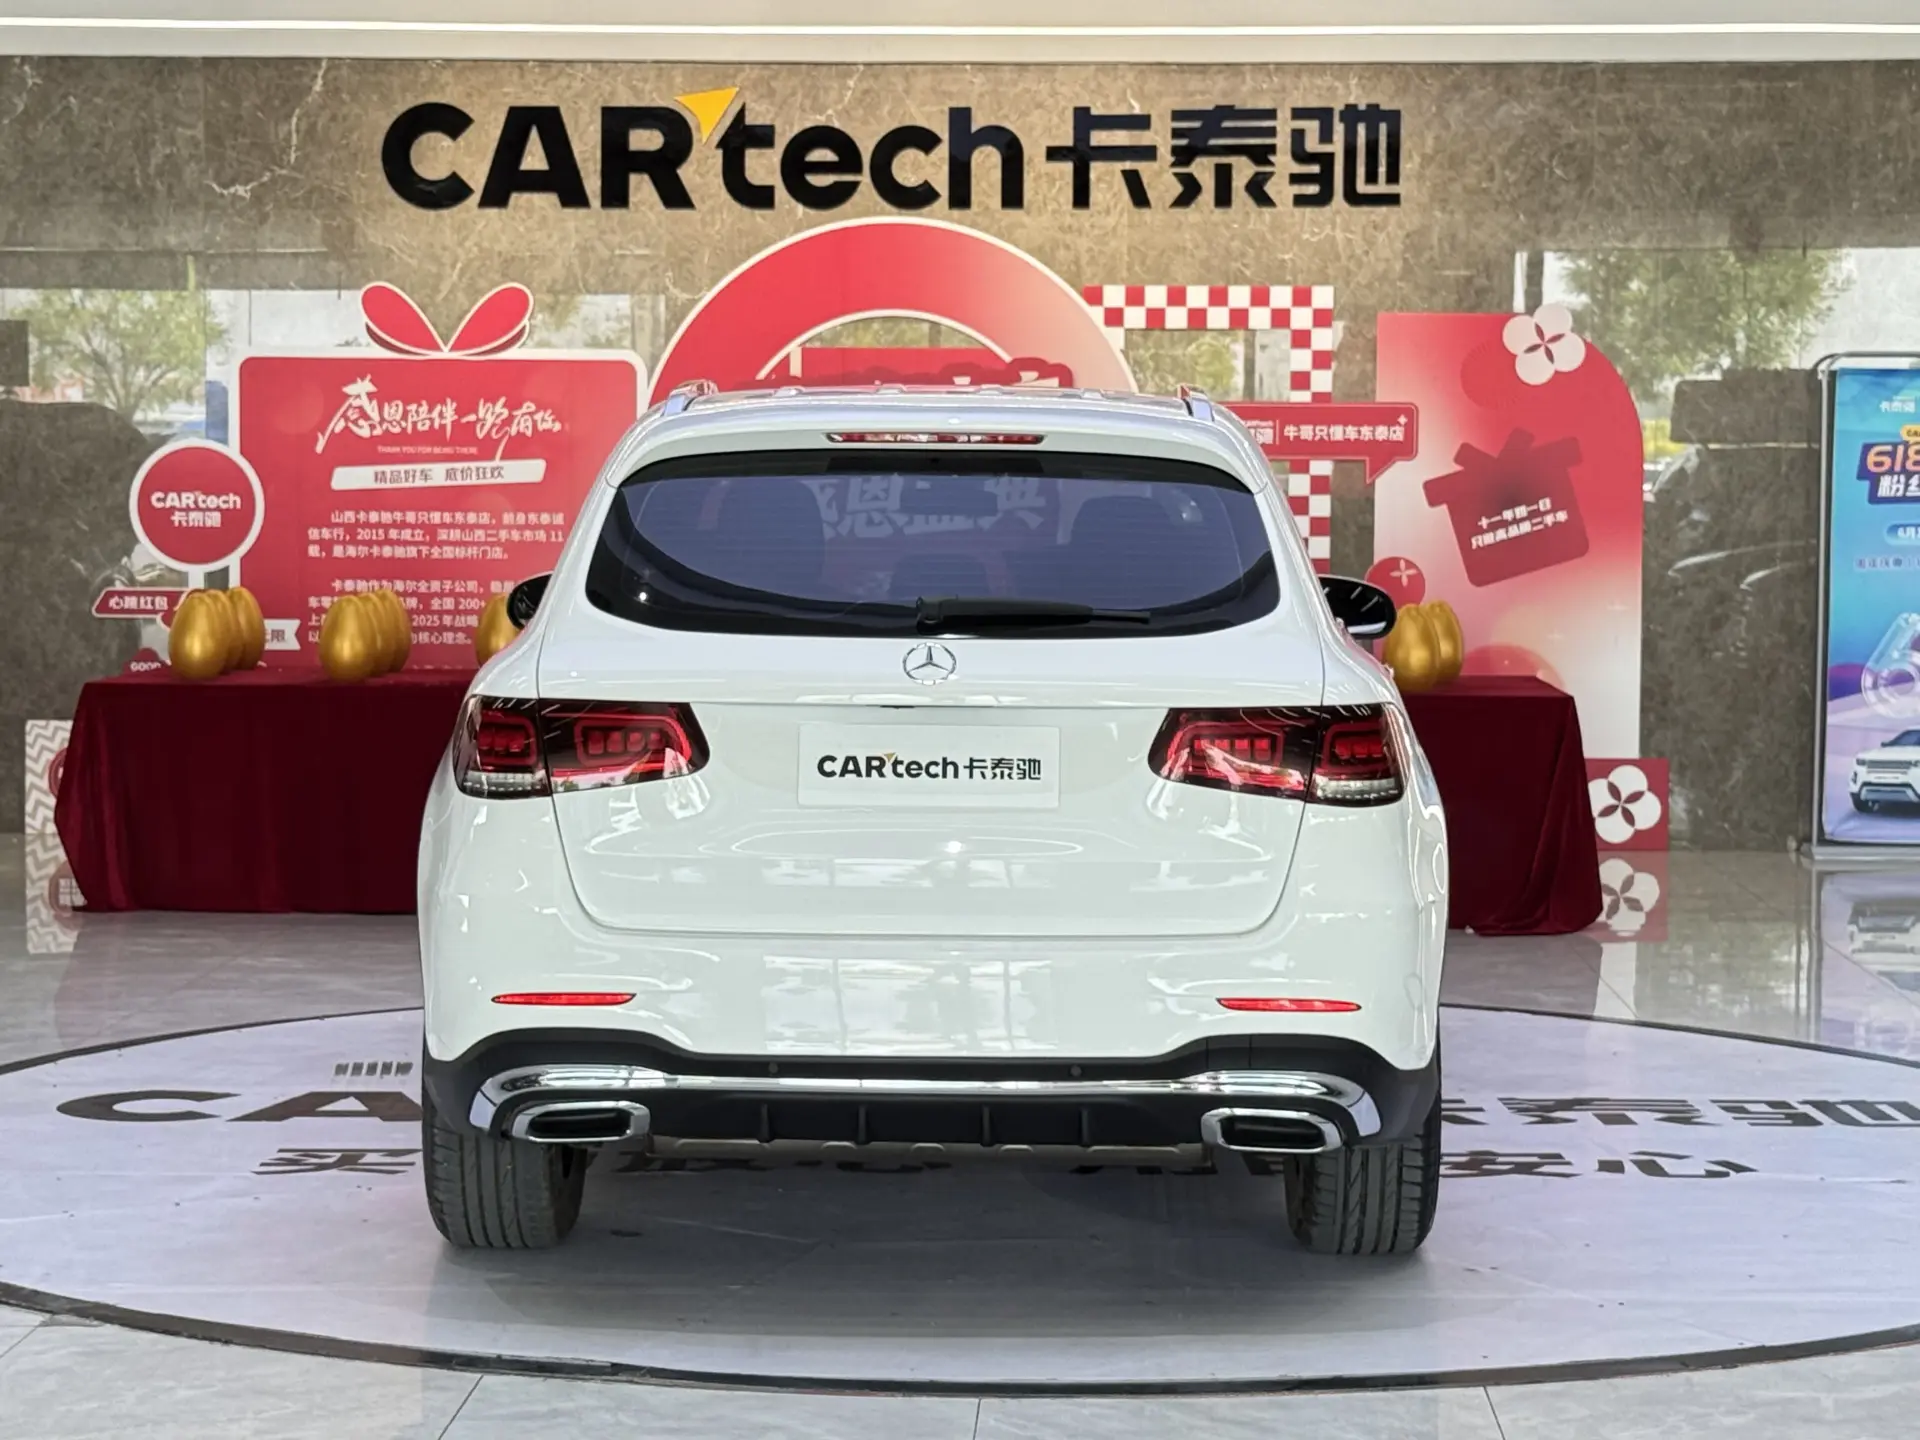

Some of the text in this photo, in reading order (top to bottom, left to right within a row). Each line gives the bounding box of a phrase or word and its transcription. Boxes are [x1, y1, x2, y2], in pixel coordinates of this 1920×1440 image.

[381, 102, 1401, 210] CARtech 卡泰驰
[1284, 425, 1405, 441] 牛哥只懂车东泰店
[1866, 444, 1920, 473] 618
[373, 465, 505, 484] 精品好车 底价狂欢
[151, 491, 242, 509] CARtech
[170, 511, 222, 528] 卡泰驰
[412, 615, 440, 627] 2025
[265, 629, 286, 642] 限
[817, 754, 1042, 781] CARtech 卡泰驰
